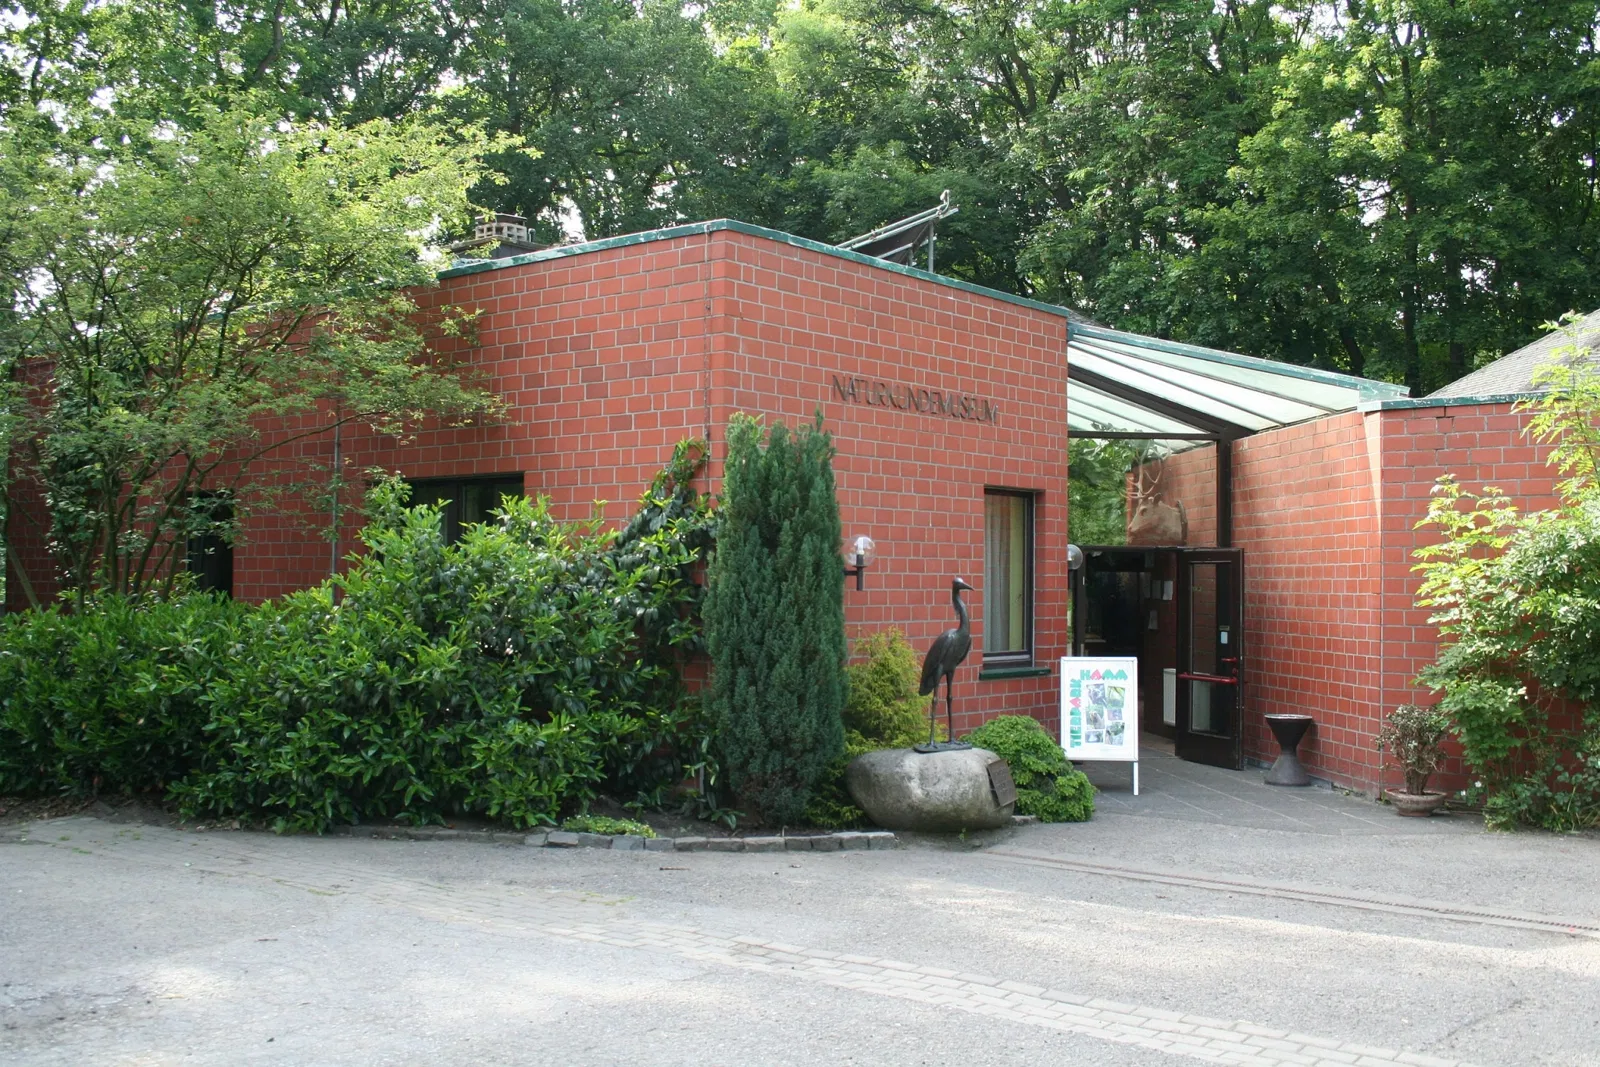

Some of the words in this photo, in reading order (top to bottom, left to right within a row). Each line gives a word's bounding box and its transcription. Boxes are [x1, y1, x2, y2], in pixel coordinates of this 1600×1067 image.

[832, 375, 998, 423] NATURKUNDEMUSEUM
[1080, 669, 1128, 680] HAMM
[1070, 679, 1081, 748] TIERPARK
